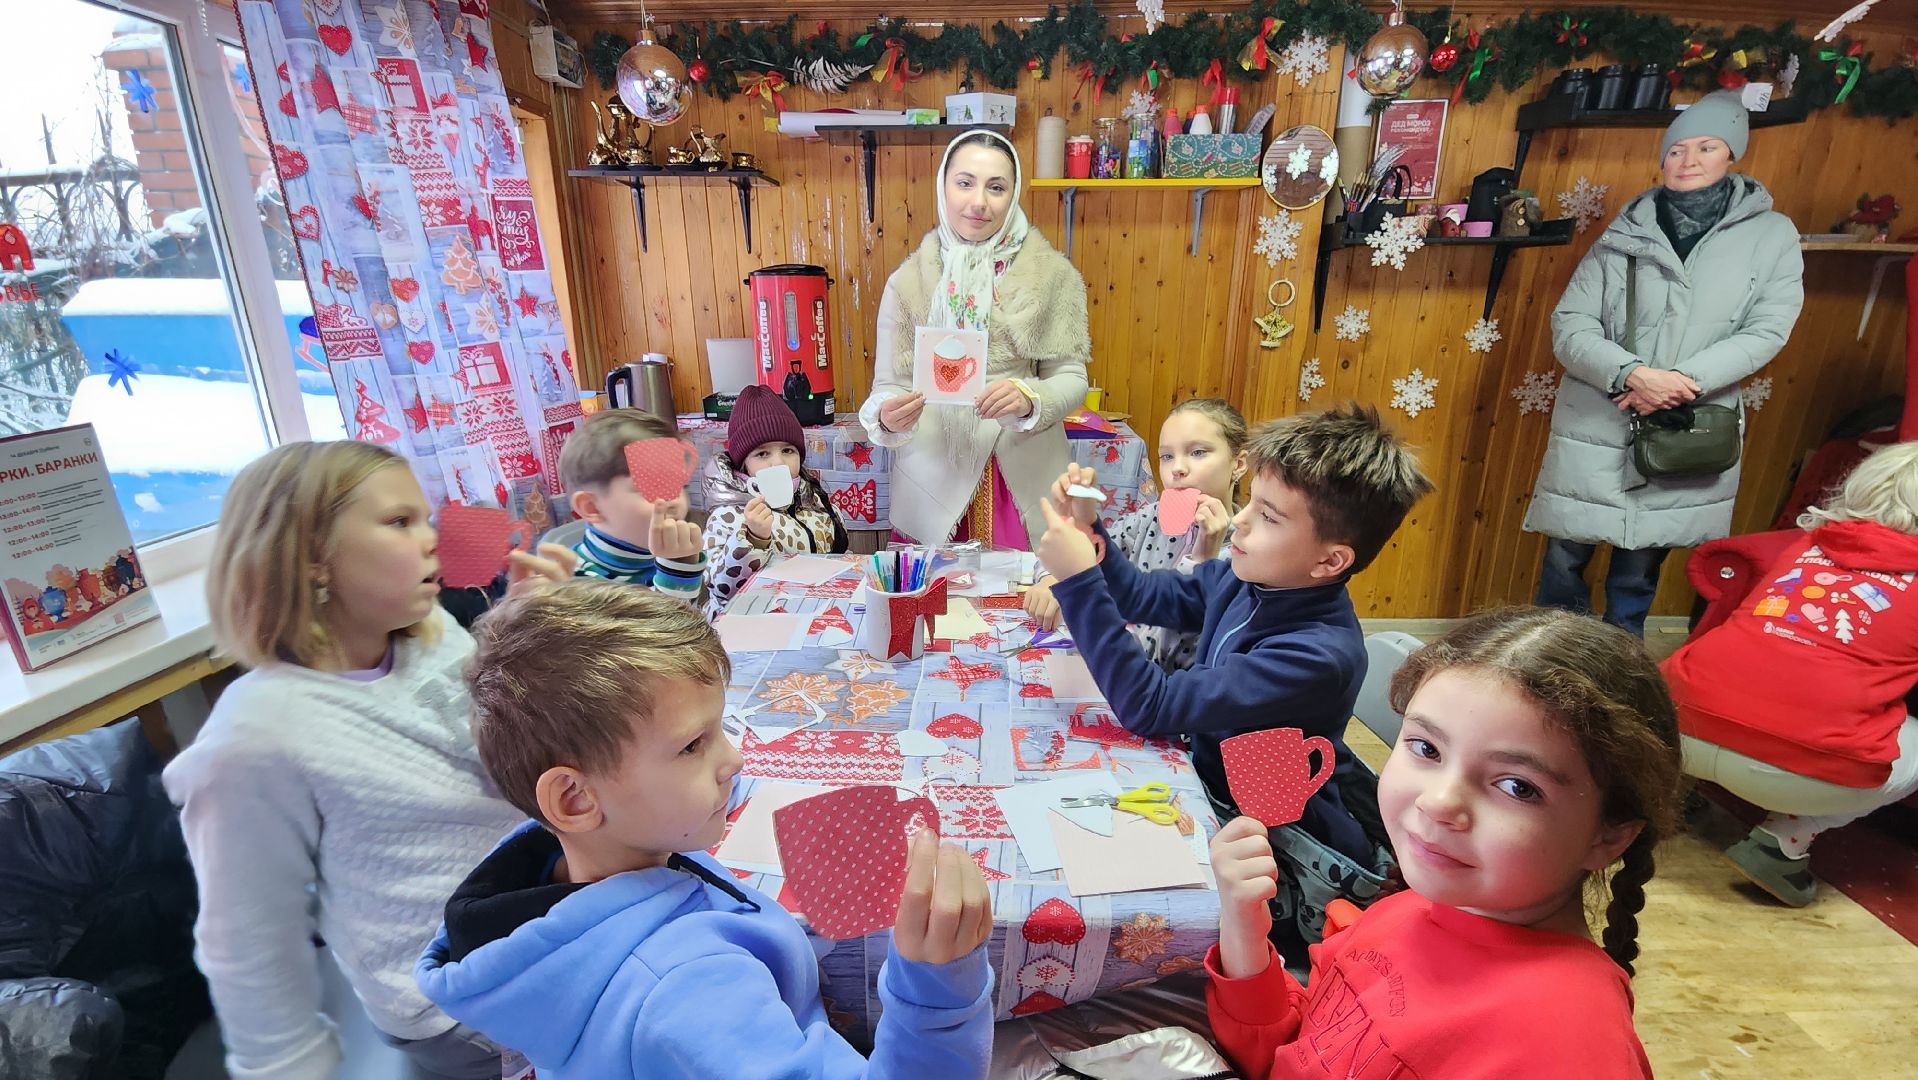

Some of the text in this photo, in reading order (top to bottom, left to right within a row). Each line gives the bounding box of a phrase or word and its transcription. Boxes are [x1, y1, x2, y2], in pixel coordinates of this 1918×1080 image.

[759, 300, 772, 369] MacCoffee
[811, 300, 828, 367] MacCoffee
[35, 452, 98, 475] БАРАНКИ
